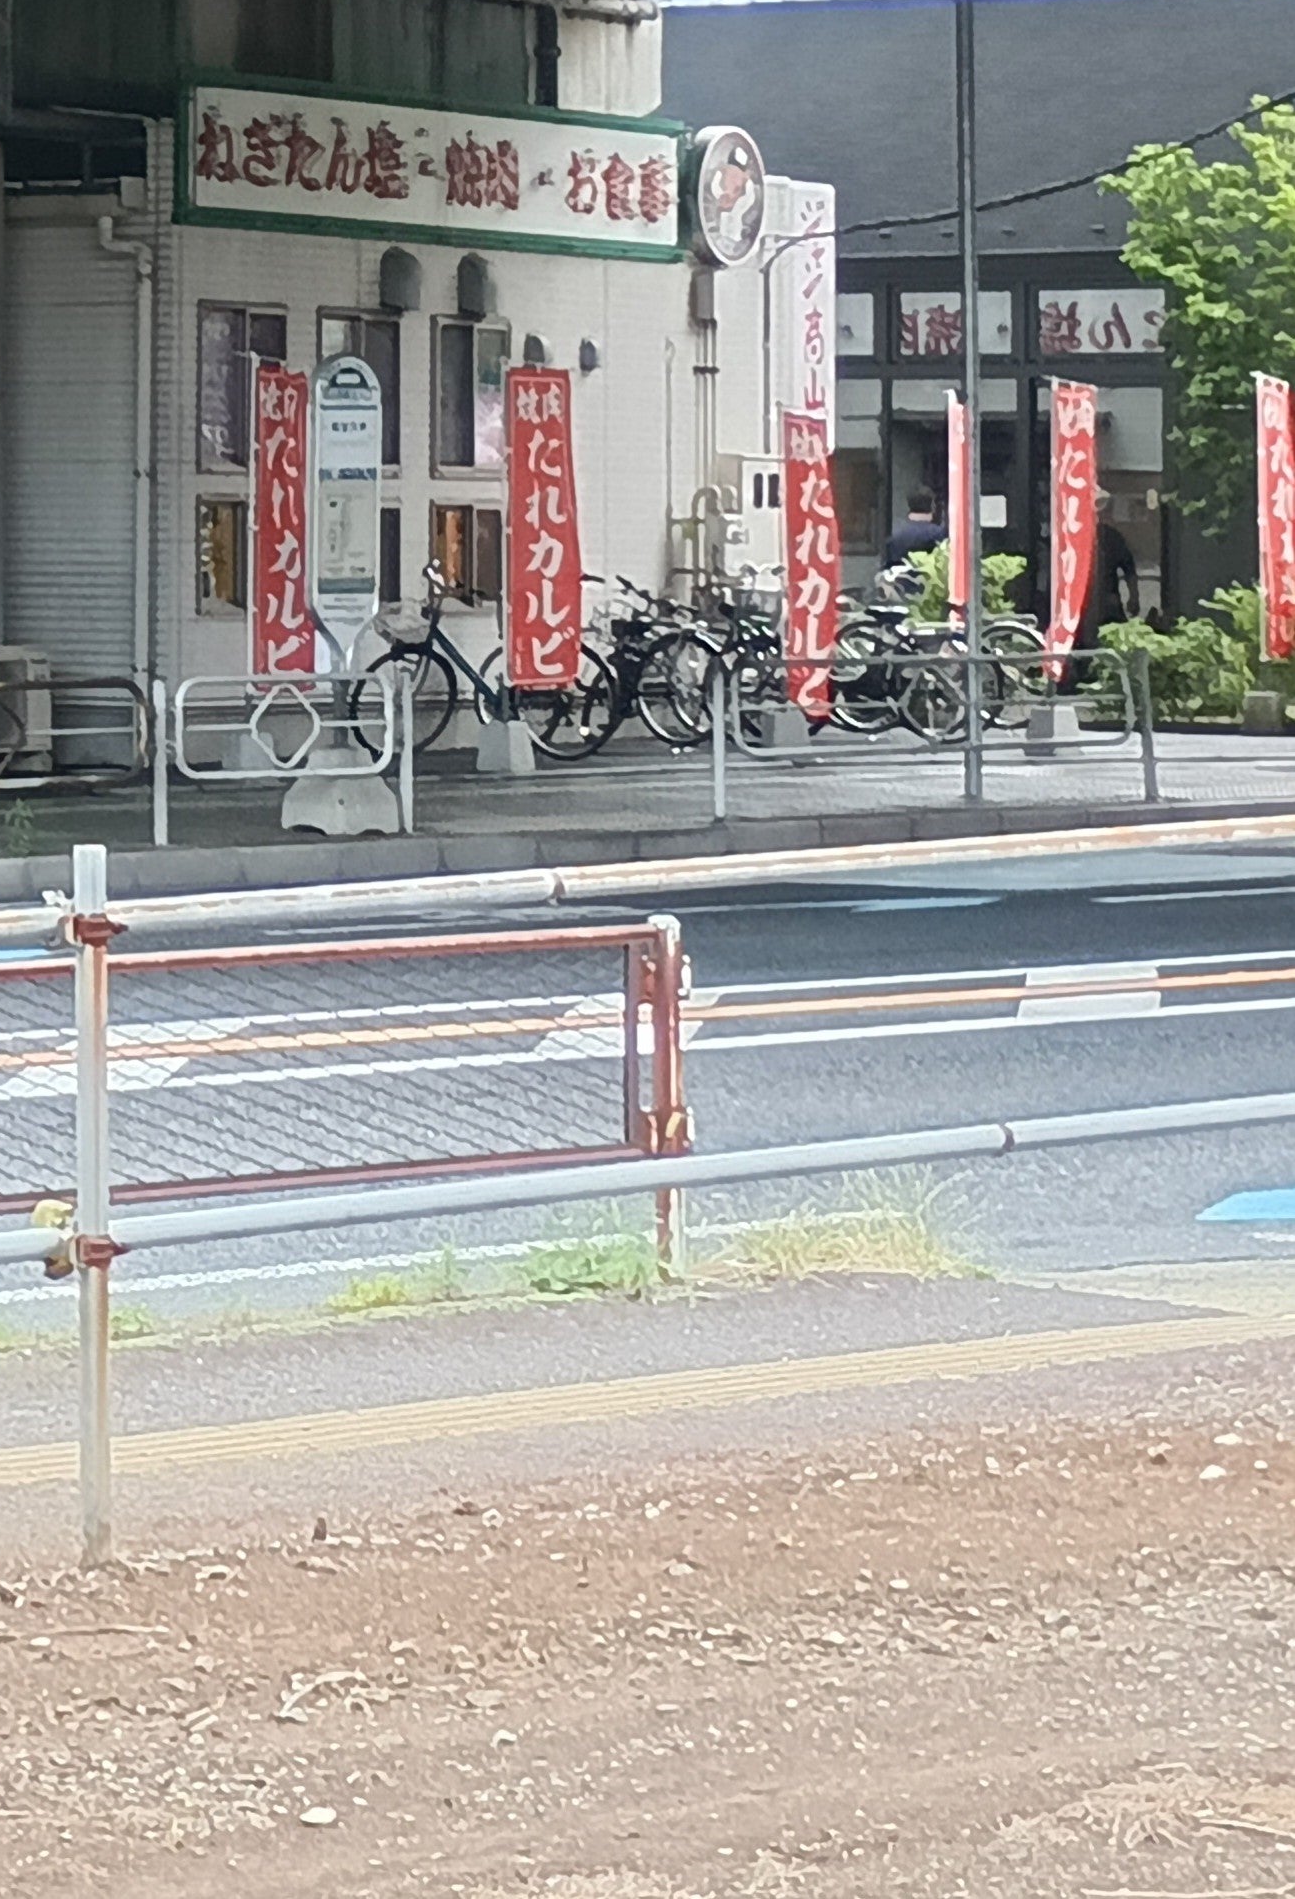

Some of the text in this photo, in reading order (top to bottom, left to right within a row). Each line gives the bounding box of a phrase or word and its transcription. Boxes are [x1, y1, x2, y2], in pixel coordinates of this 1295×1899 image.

[524, 428, 575, 676] たれカルビ
